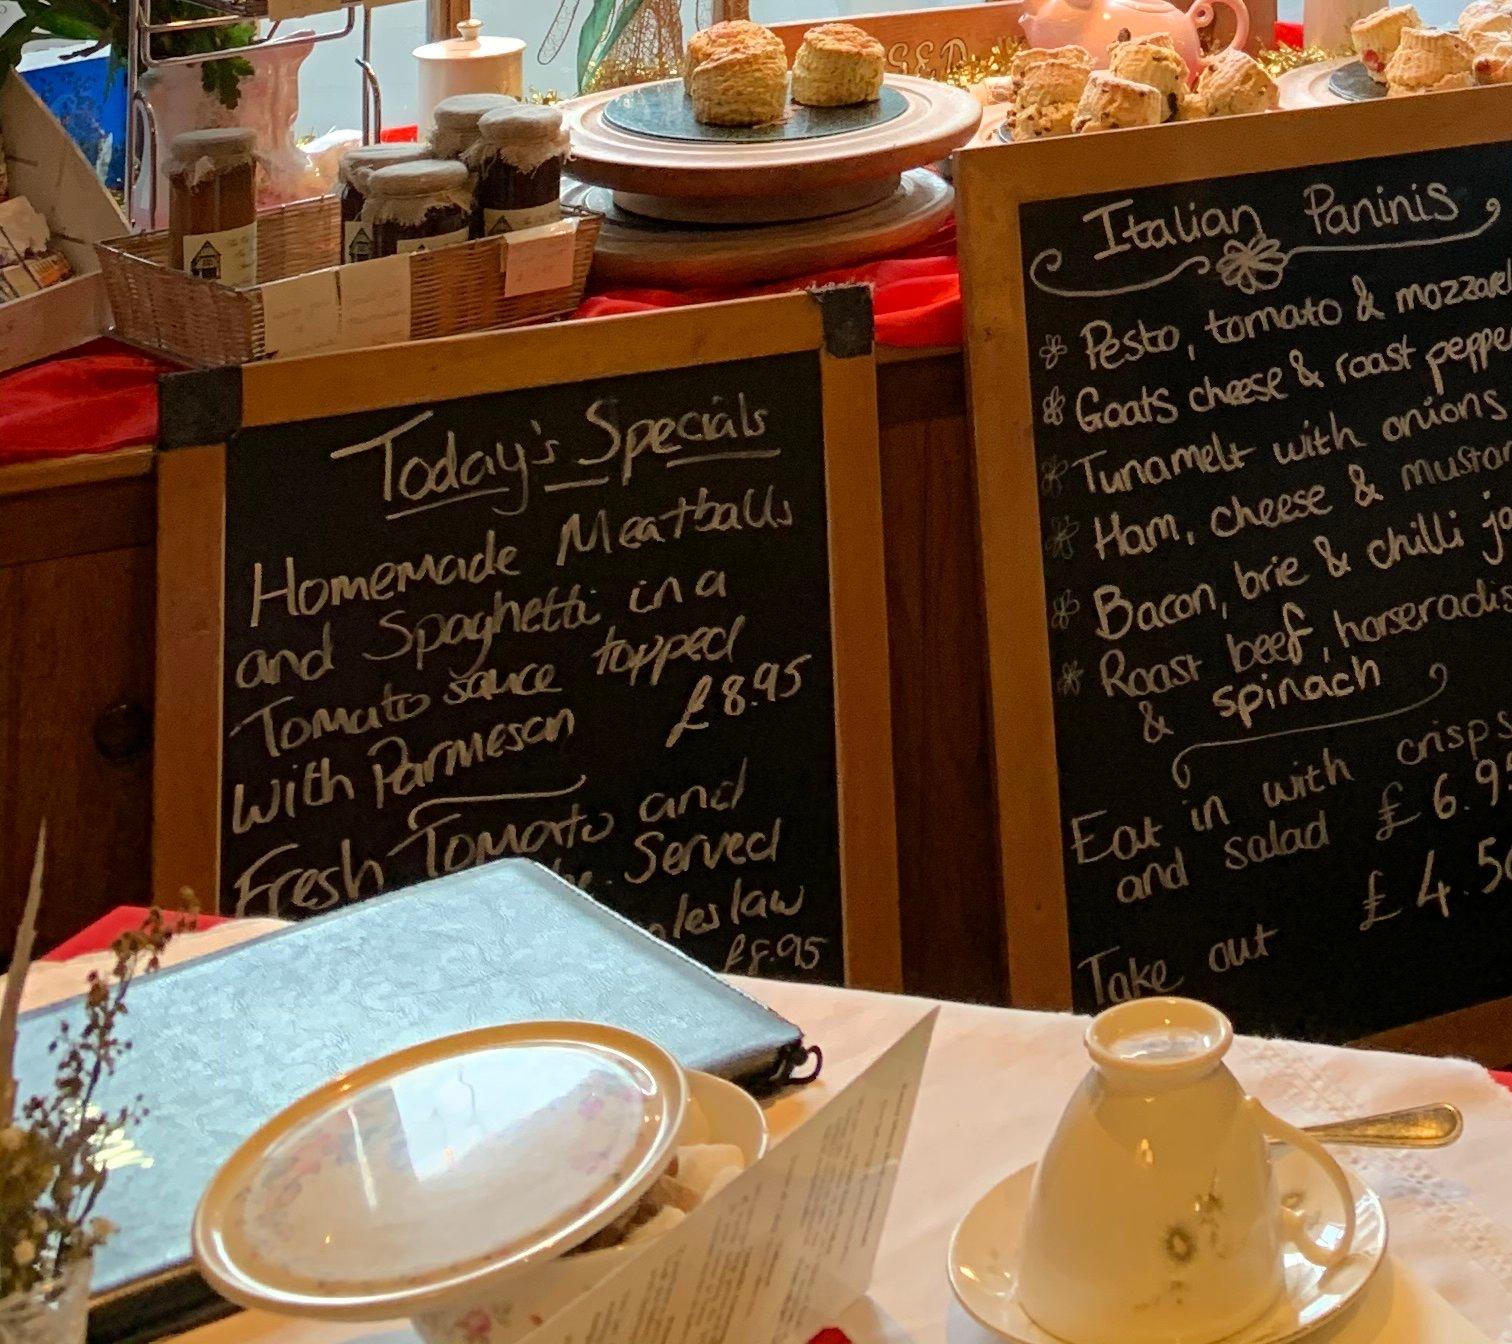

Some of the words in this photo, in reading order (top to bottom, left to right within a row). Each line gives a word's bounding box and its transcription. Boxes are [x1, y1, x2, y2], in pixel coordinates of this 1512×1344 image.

[1082, 198, 1264, 261] Italian
[1303, 181, 1461, 238] Paninis
[1204, 295, 1344, 346] tomato
[1353, 275, 1385, 323] &
[1075, 384, 1179, 433] Goats
[1188, 366, 1288, 413] cheese
[1289, 349, 1324, 389] &
[1335, 333, 1415, 385] roast
[1272, 418, 1367, 466] with
[1381, 387, 1508, 443] onions
[330, 410, 560, 516] Today's
[578, 392, 769, 486] Specials
[1209, 484, 1333, 538] cheese
[1346, 465, 1384, 508] &
[250, 530, 520, 628] Homemade
[555, 485, 794, 568] Meatballs
[1234, 554, 1309, 602] brie
[1312, 536, 1352, 577] &
[1365, 510, 1464, 571] chilli
[234, 621, 334, 690] and
[362, 585, 603, 682] Spaghetti
[629, 577, 683, 614] in
[693, 568, 728, 602] a
[1097, 649, 1206, 700] Roast
[230, 675, 431, 759] Tomato
[446, 660, 565, 707] sauce
[592, 615, 748, 689] topped
[1142, 700, 1174, 745] &
[1210, 654, 1383, 729] spinach
[233, 839, 384, 917] Fresh
[638, 758, 748, 822] and
[623, 817, 782, 886] Served
[1069, 809, 1163, 865] Eat
[1190, 794, 1230, 834] in
[1262, 748, 1356, 810] with
[1115, 847, 1190, 904] and
[1224, 811, 1331, 872] salad
[1077, 944, 1185, 1004] Take
[1208, 922, 1279, 973] out
